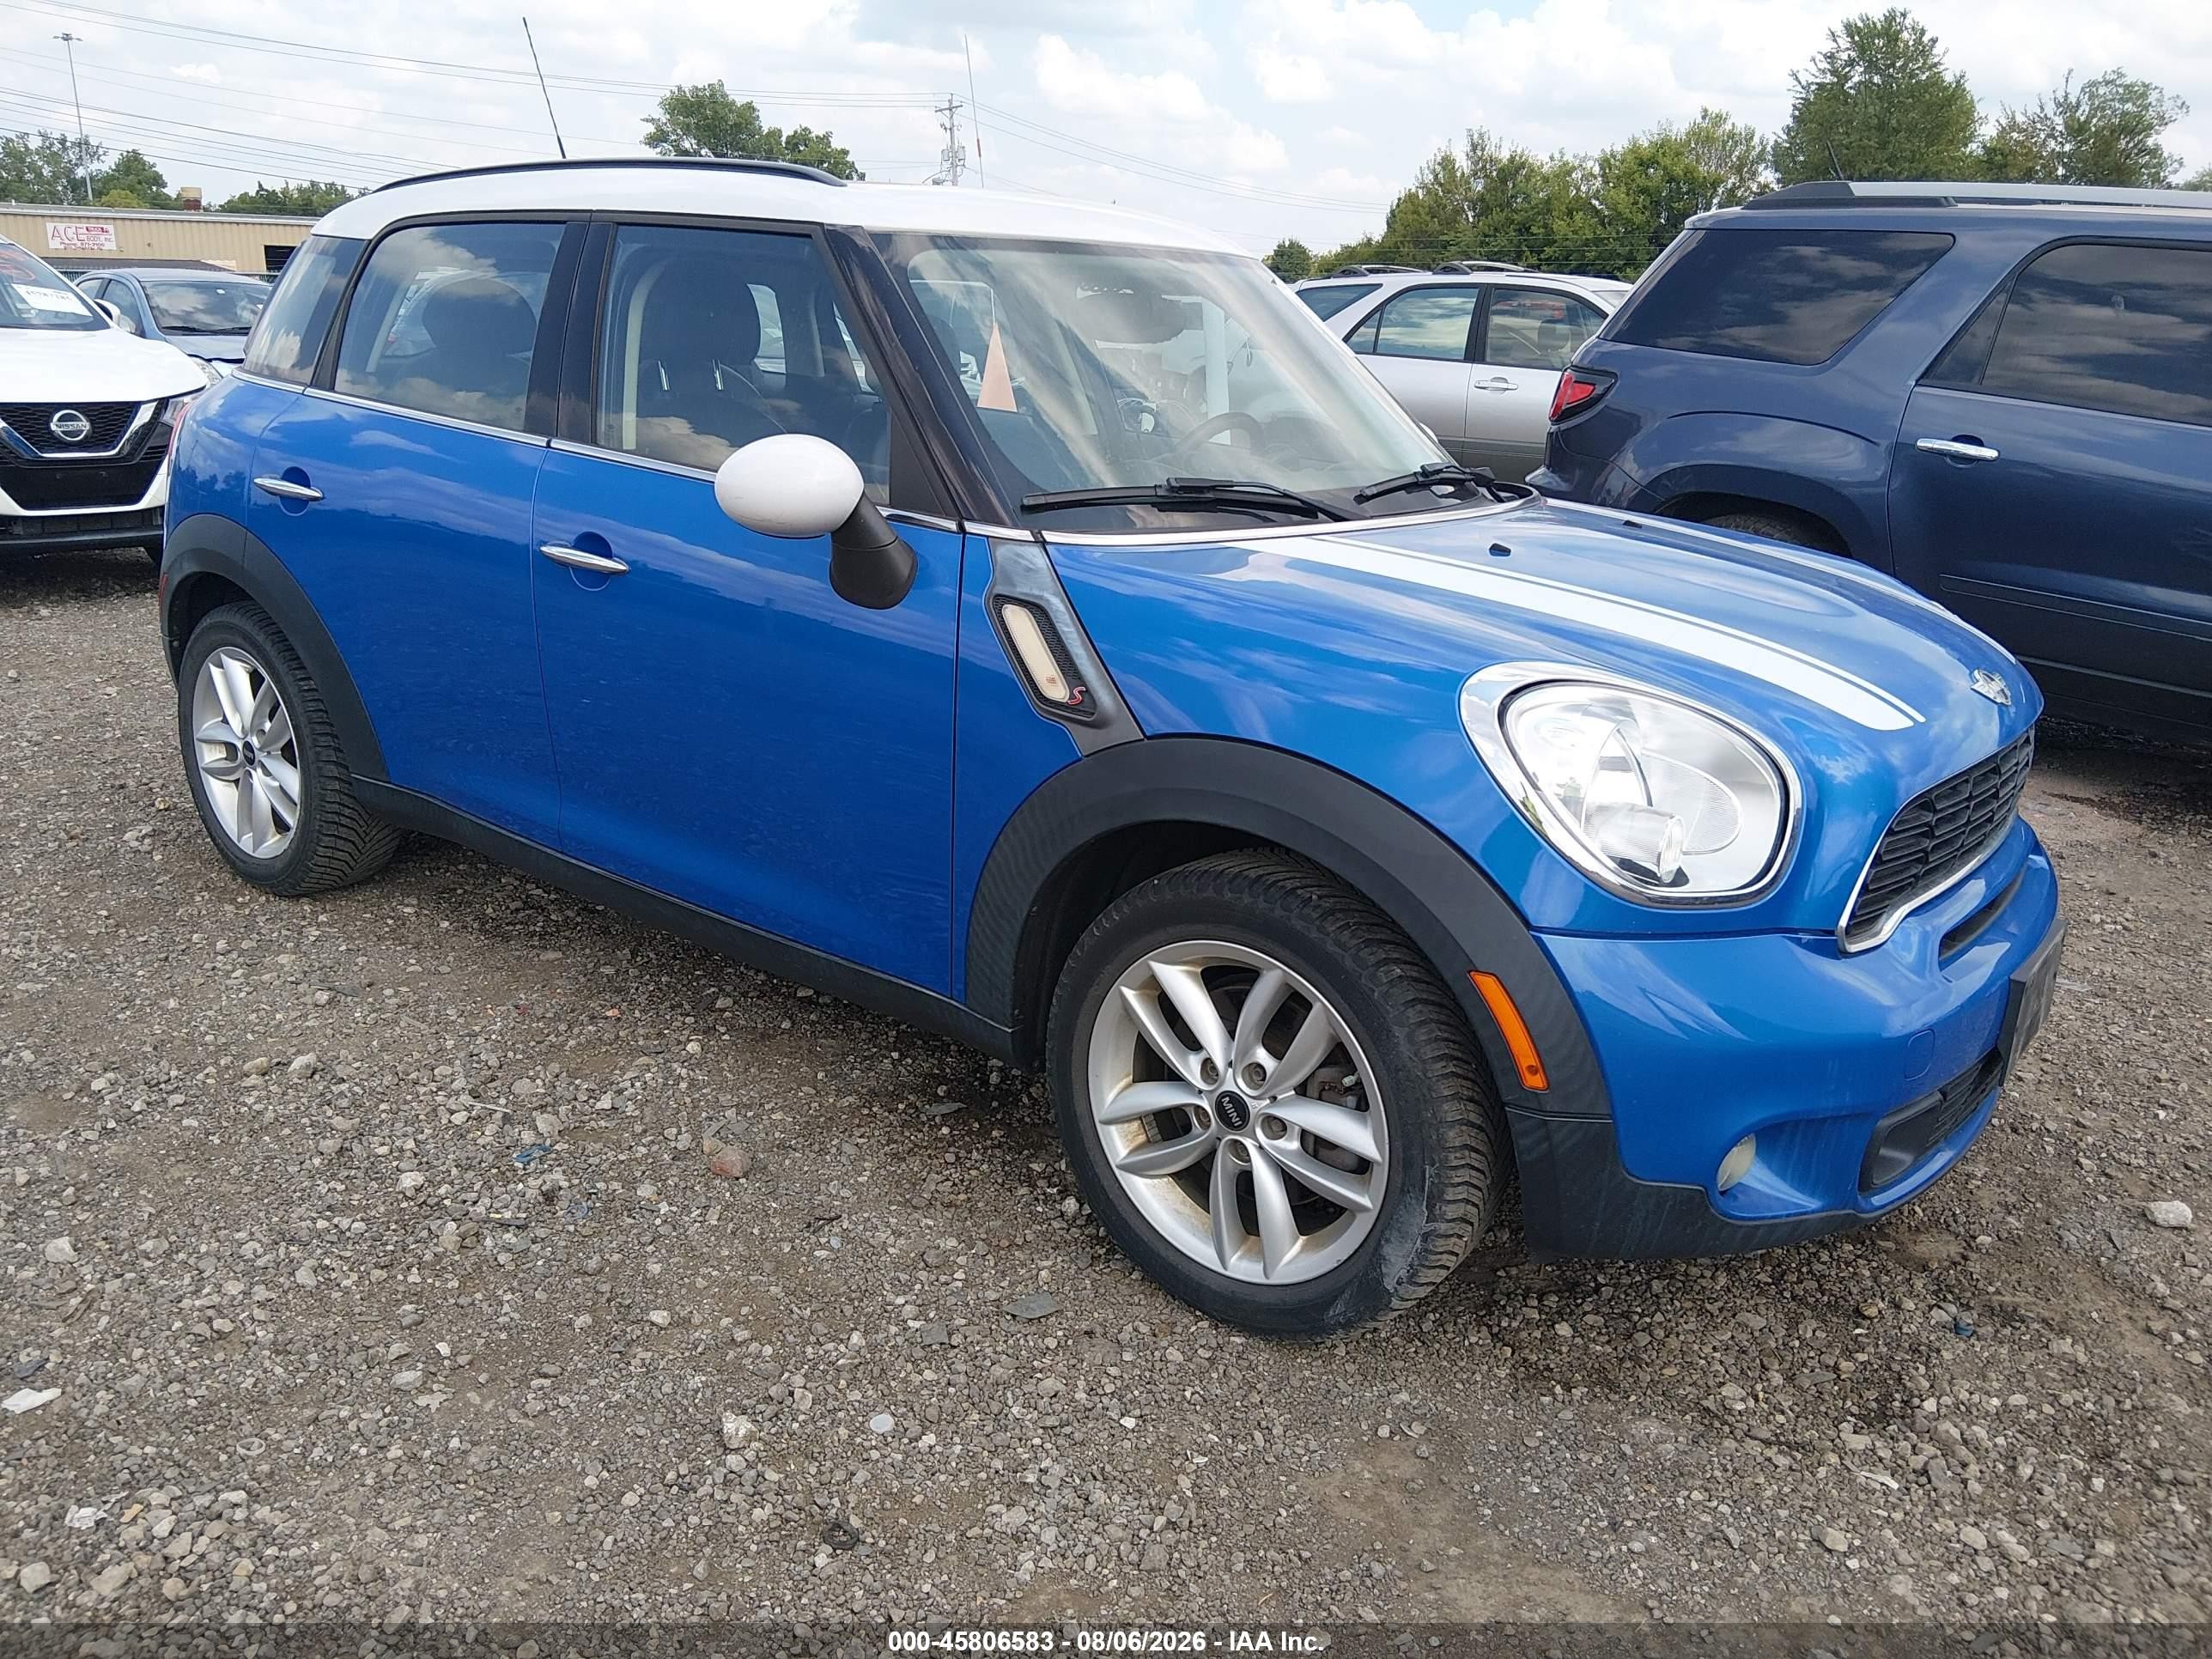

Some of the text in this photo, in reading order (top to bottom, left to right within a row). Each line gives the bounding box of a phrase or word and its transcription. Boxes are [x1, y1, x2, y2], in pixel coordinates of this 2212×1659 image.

[52, 226, 85, 241] ACE
[1067, 686, 1085, 704] S
[1221, 1097, 1243, 1127] MINI
